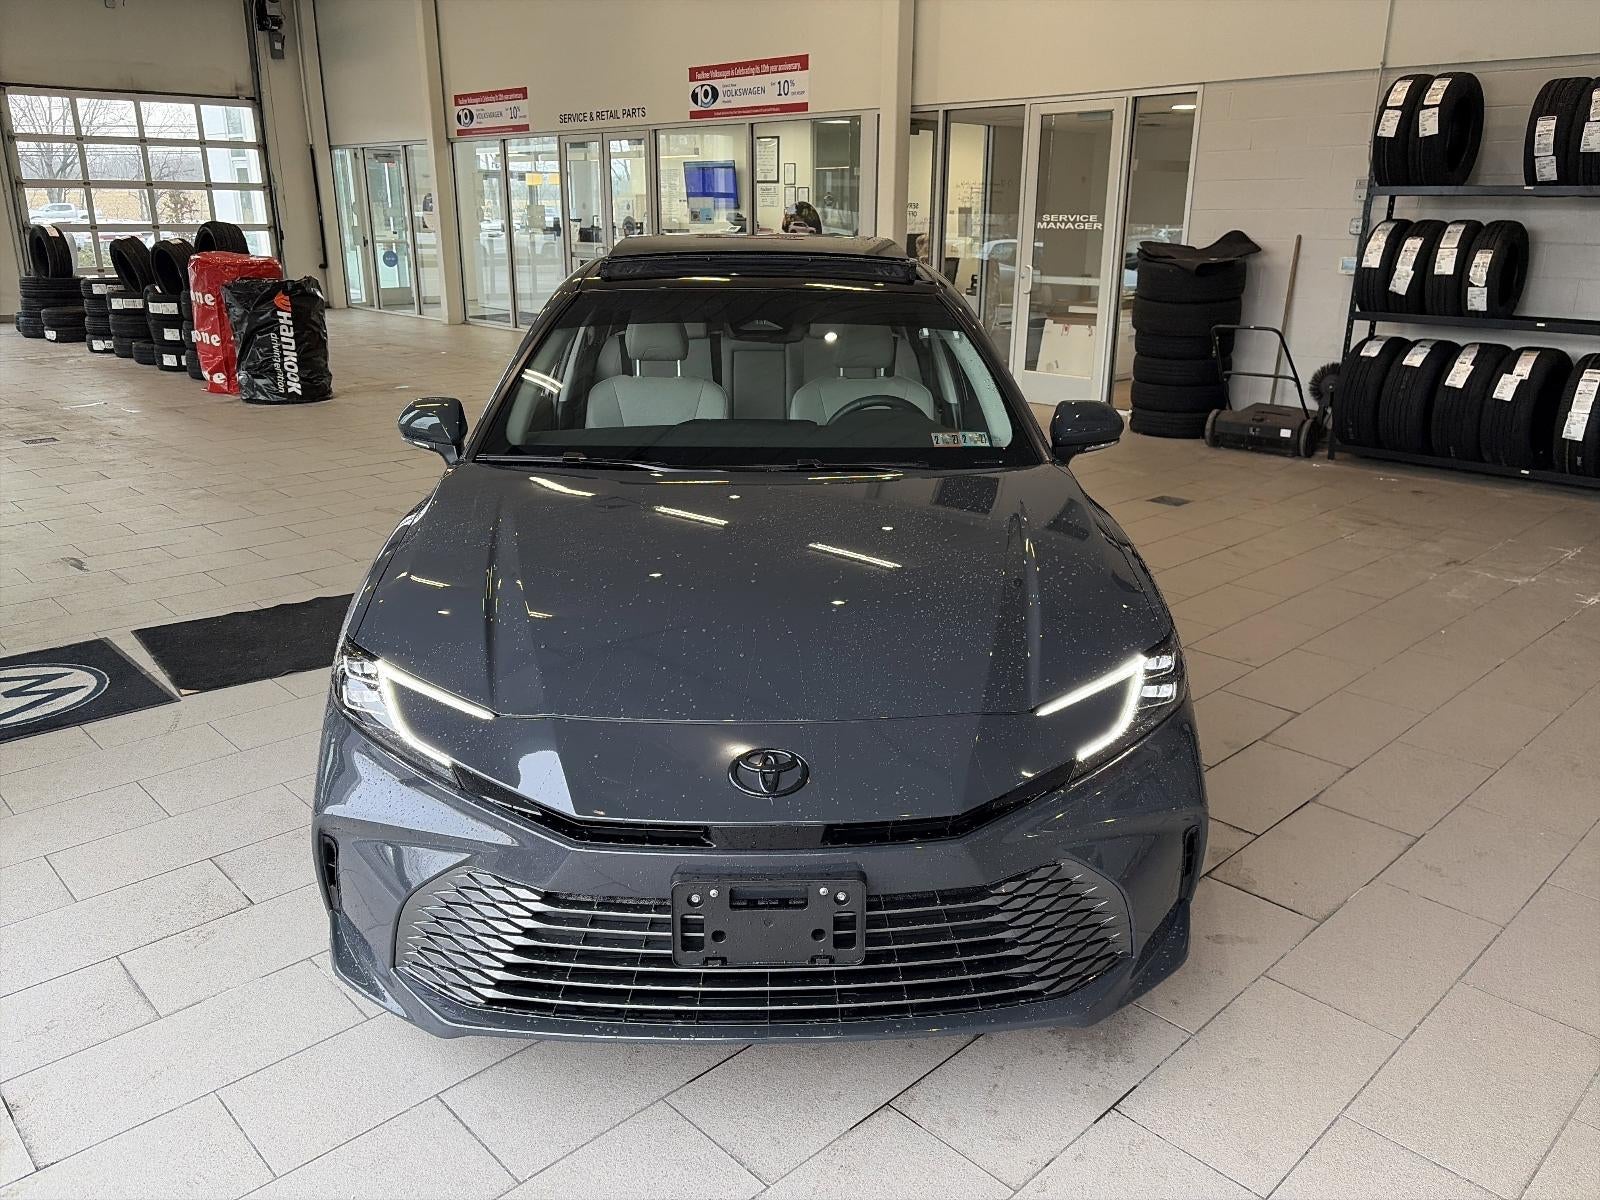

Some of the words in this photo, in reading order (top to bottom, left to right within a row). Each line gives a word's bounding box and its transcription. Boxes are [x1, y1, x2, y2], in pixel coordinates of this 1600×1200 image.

[710, 69, 731, 79] Volkswagen
[735, 65, 755, 77] Celebrating
[722, 86, 766, 98] VOLKSWAGEN
[559, 112, 587, 123] SERVICE
[589, 111, 594, 121] &
[596, 109, 620, 121] RETAIL
[622, 107, 646, 118] PARTS
[1042, 214, 1098, 222] SERVICE
[1037, 222, 1103, 230] MANAGER
